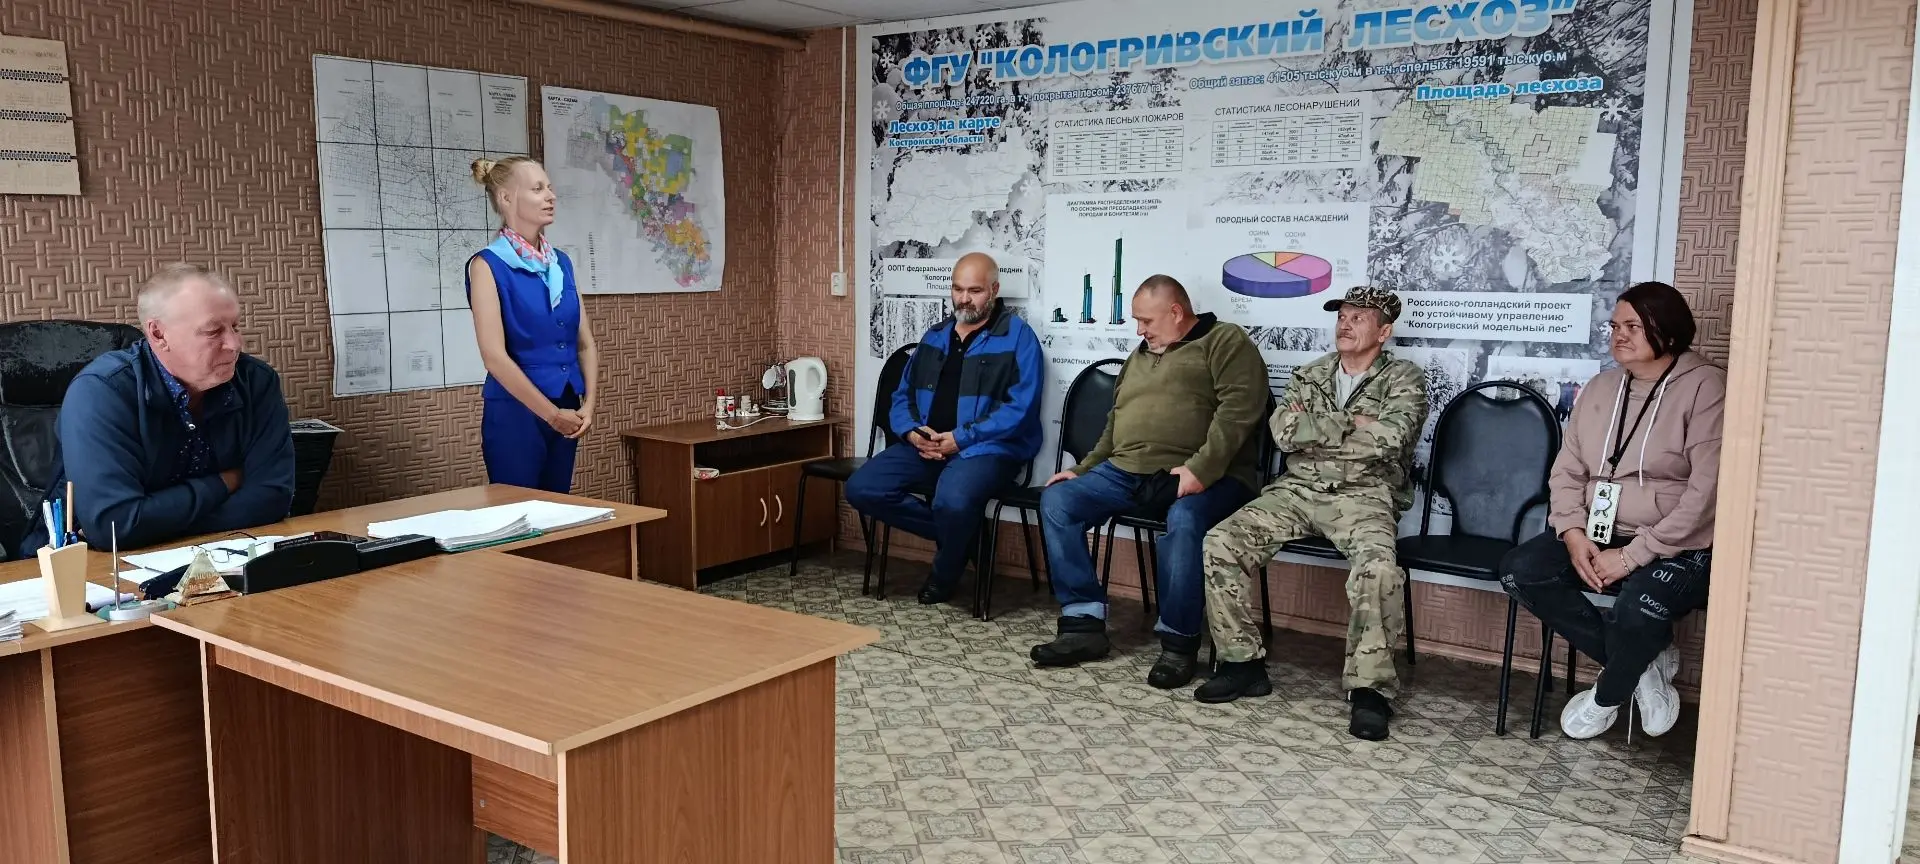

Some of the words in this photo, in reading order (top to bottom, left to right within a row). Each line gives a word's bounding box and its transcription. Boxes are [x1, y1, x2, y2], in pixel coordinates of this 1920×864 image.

[904, 53, 970, 86] ФГУ
[981, 8, 1323, 79] "КОЛОГРИВСКИЙ
[1189, 75, 1227, 89] Общий
[1229, 75, 1265, 88] запас:
[1267, 69, 1300, 83] 41505
[1302, 65, 1361, 81] тыс.куб.м
[1365, 67, 1373, 75] в
[1399, 60, 1453, 74] спелых:
[1457, 54, 1493, 69] 19591
[1497, 50, 1567, 66] тыс.куб.м
[1416, 83, 1511, 101] Площадь
[1515, 76, 1604, 94] лесхоза
[895, 99, 923, 111] Общая
[924, 98, 963, 109] площадь:
[965, 94, 994, 106] 247220
[1033, 88, 1078, 102] покрытая
[1080, 86, 1114, 99] лесом:
[1115, 82, 1149, 94] 237677
[1151, 83, 1161, 92] га
[1214, 104, 1271, 116] СТАТИСТИКА
[1274, 98, 1360, 112] ЛЕСОНАРУШЕНИЙ
[889, 120, 936, 133] Лесхоз
[940, 120, 955, 130] на
[959, 117, 1000, 131] карте
[1054, 118, 1104, 128] СТАТИСТИКА
[1105, 115, 1140, 125] ЛЕСНЫХ
[1142, 112, 1184, 123] ПОЖАРОВ
[889, 137, 944, 148] Костромской
[947, 134, 984, 144] области
[1215, 214, 1258, 224] ПОРОДНЫЙ
[1260, 215, 1291, 223] СОСТАВ
[1293, 213, 1349, 223] НАСАЖДЕНИЙ
[887, 264, 905, 272] ООПТ
[906, 264, 951, 273] федерального
[1407, 298, 1531, 310] Российско-голландский
[1533, 302, 1572, 312] проект
[1412, 310, 1424, 318] по
[1426, 309, 1494, 321] устойчивому
[1496, 312, 1564, 323] управлению
[1482, 322, 1545, 333] модельный
[1052, 357, 1091, 365] ВОЗРАСТНАЯ
[1652, 569, 1673, 582] OU
